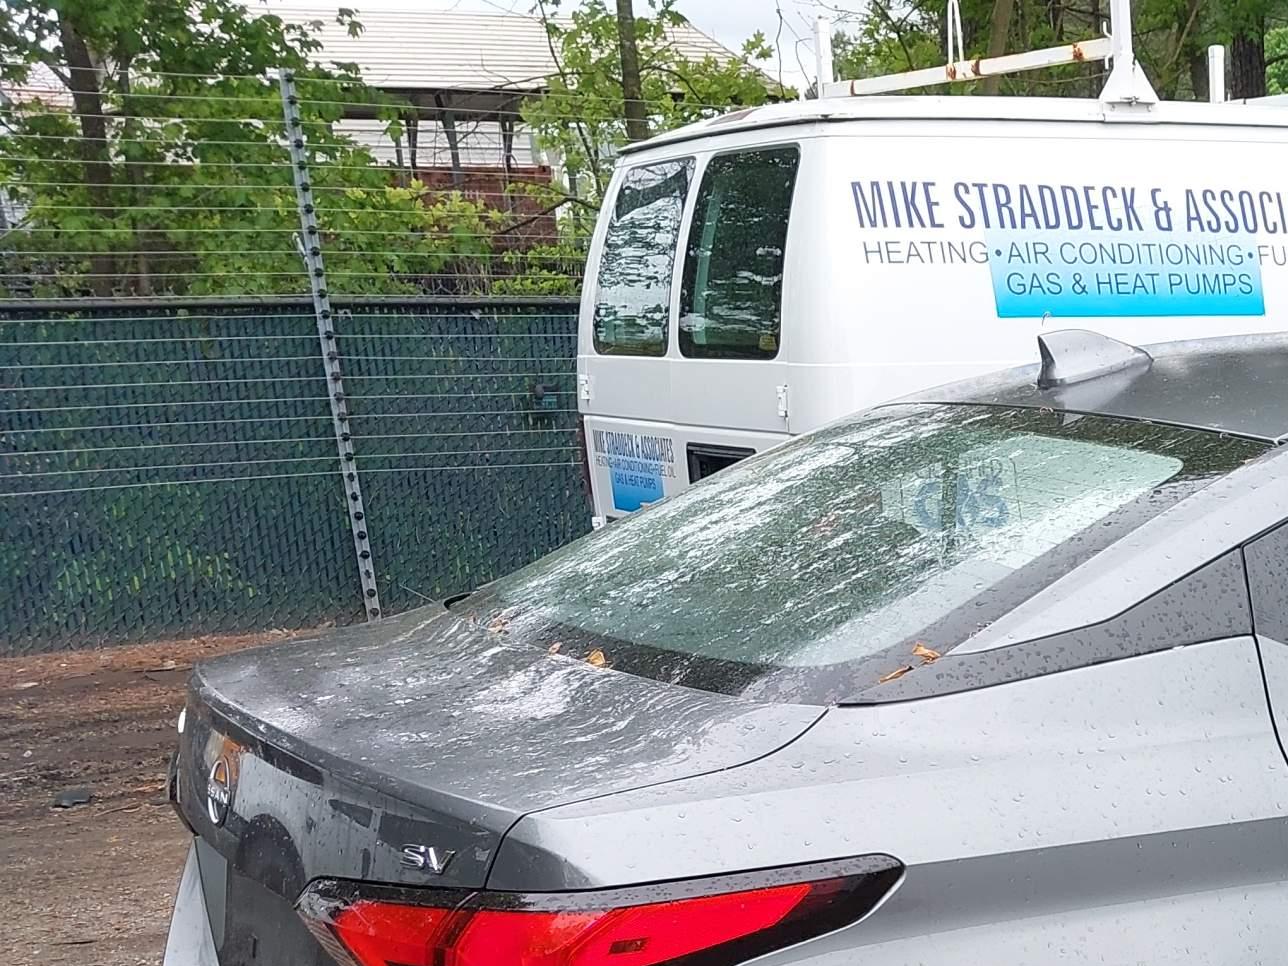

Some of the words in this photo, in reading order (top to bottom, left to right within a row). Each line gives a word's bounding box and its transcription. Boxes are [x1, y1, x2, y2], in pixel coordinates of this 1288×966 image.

[851, 181, 945, 229] MIKE
[953, 181, 1144, 232] STRADDECK
[1150, 187, 1173, 232] &
[1006, 272, 1063, 295] GAS
[1071, 272, 1089, 295] &
[1095, 272, 1160, 295] HEAT
[1168, 273, 1254, 295] PUMPS
[399, 843, 458, 876] SV
